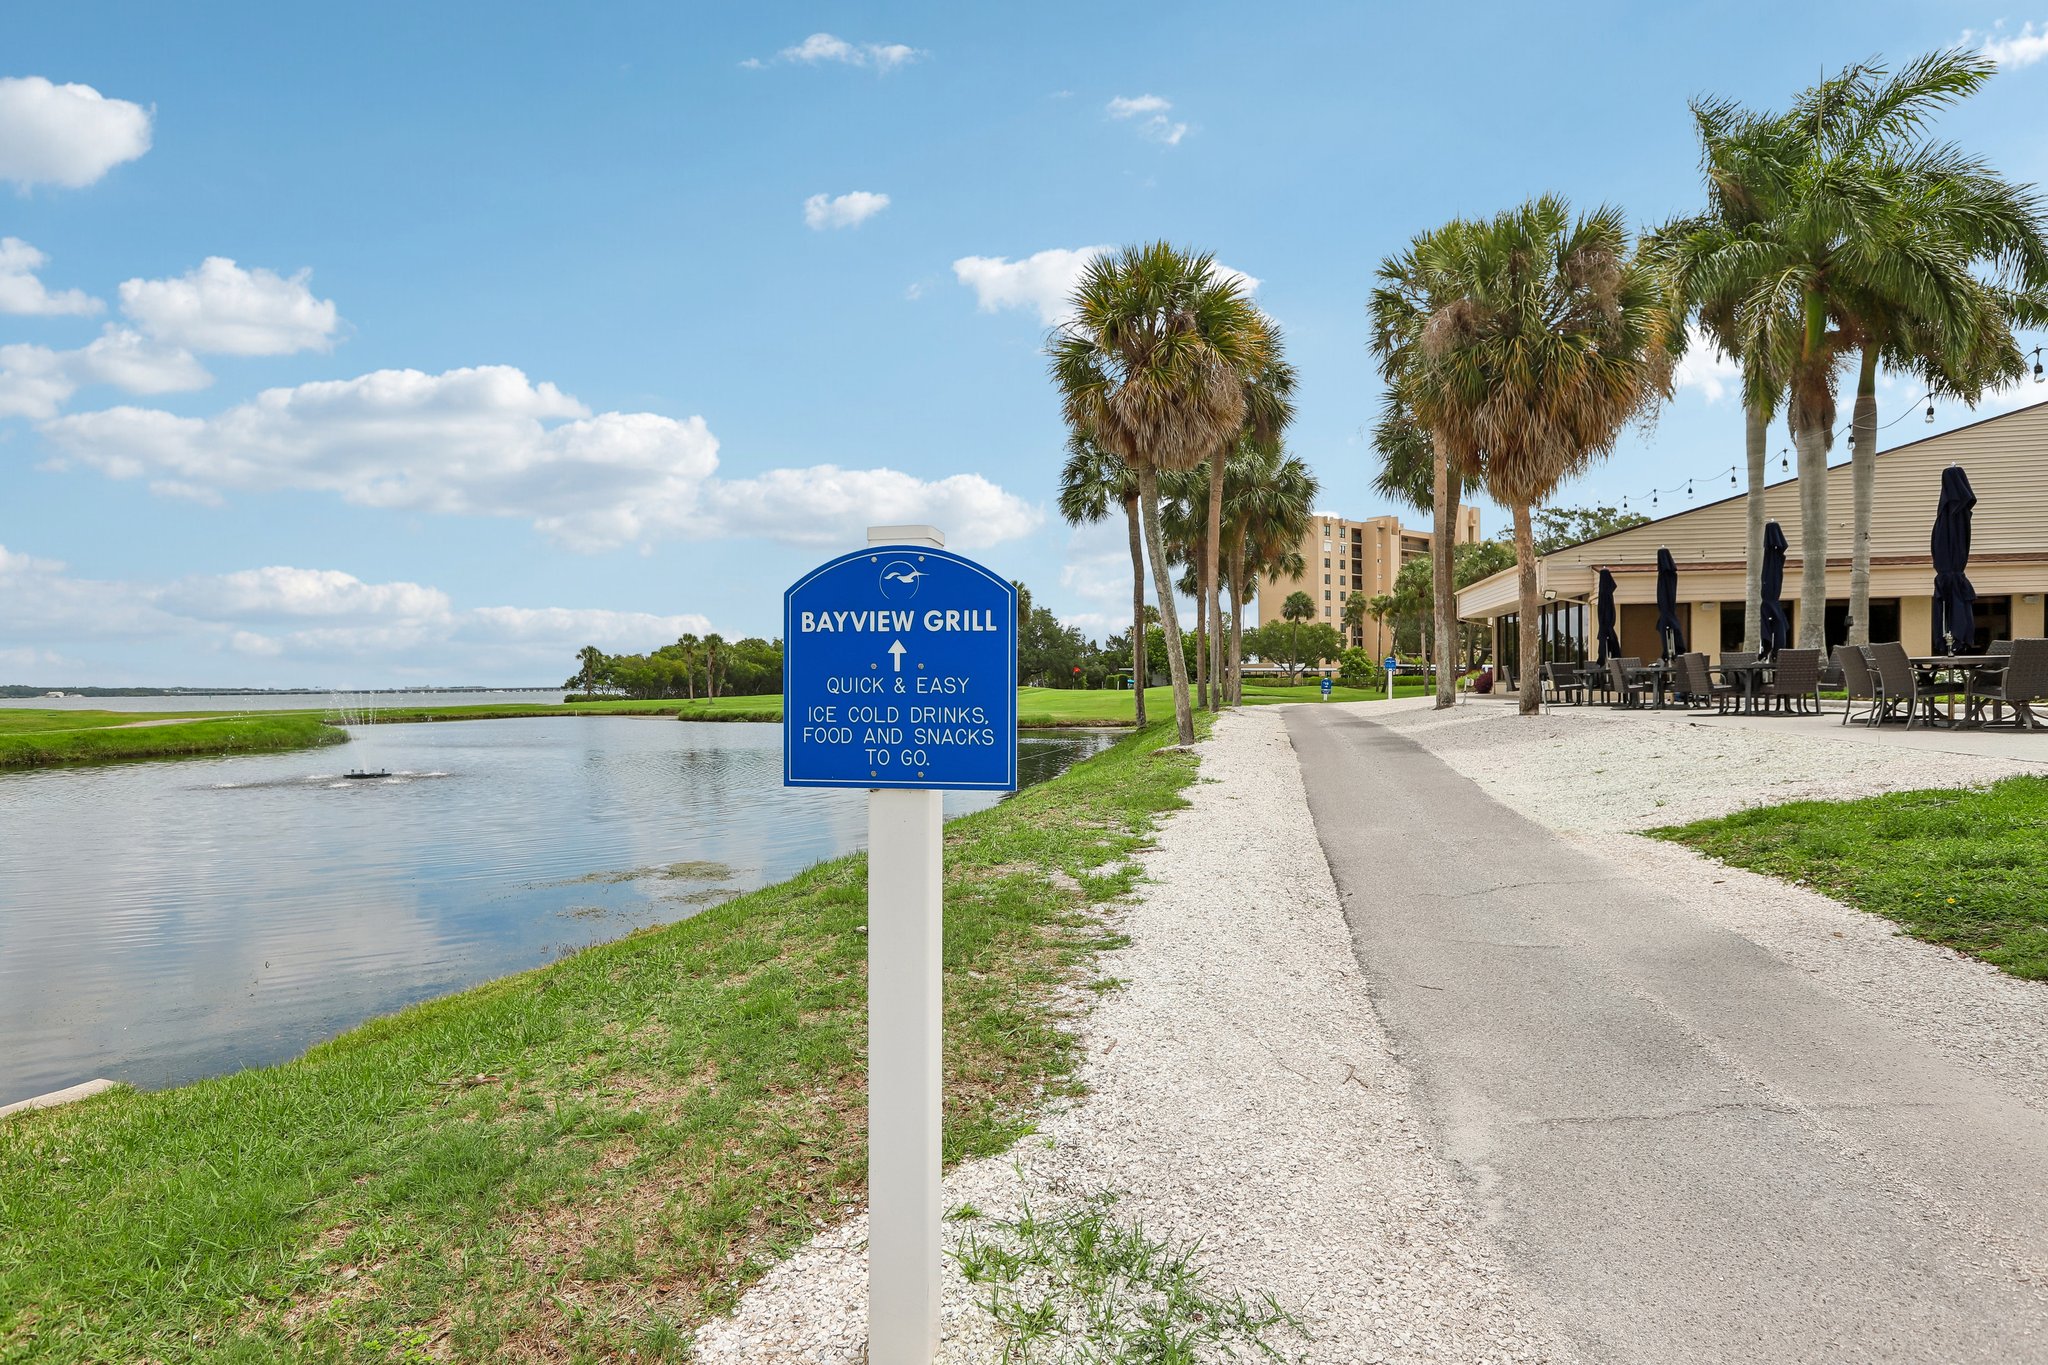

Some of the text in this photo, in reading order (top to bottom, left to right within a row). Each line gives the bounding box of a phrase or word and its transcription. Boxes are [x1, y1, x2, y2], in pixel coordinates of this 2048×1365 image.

[802, 610, 997, 632] BAYVIEW GRILL
[827, 677, 969, 694] QUICK & EASY
[809, 707, 988, 724] ICE COLD DRINKS,
[804, 727, 994, 745] FOOD AND SNACKS
[865, 749, 929, 766] TO GO.
